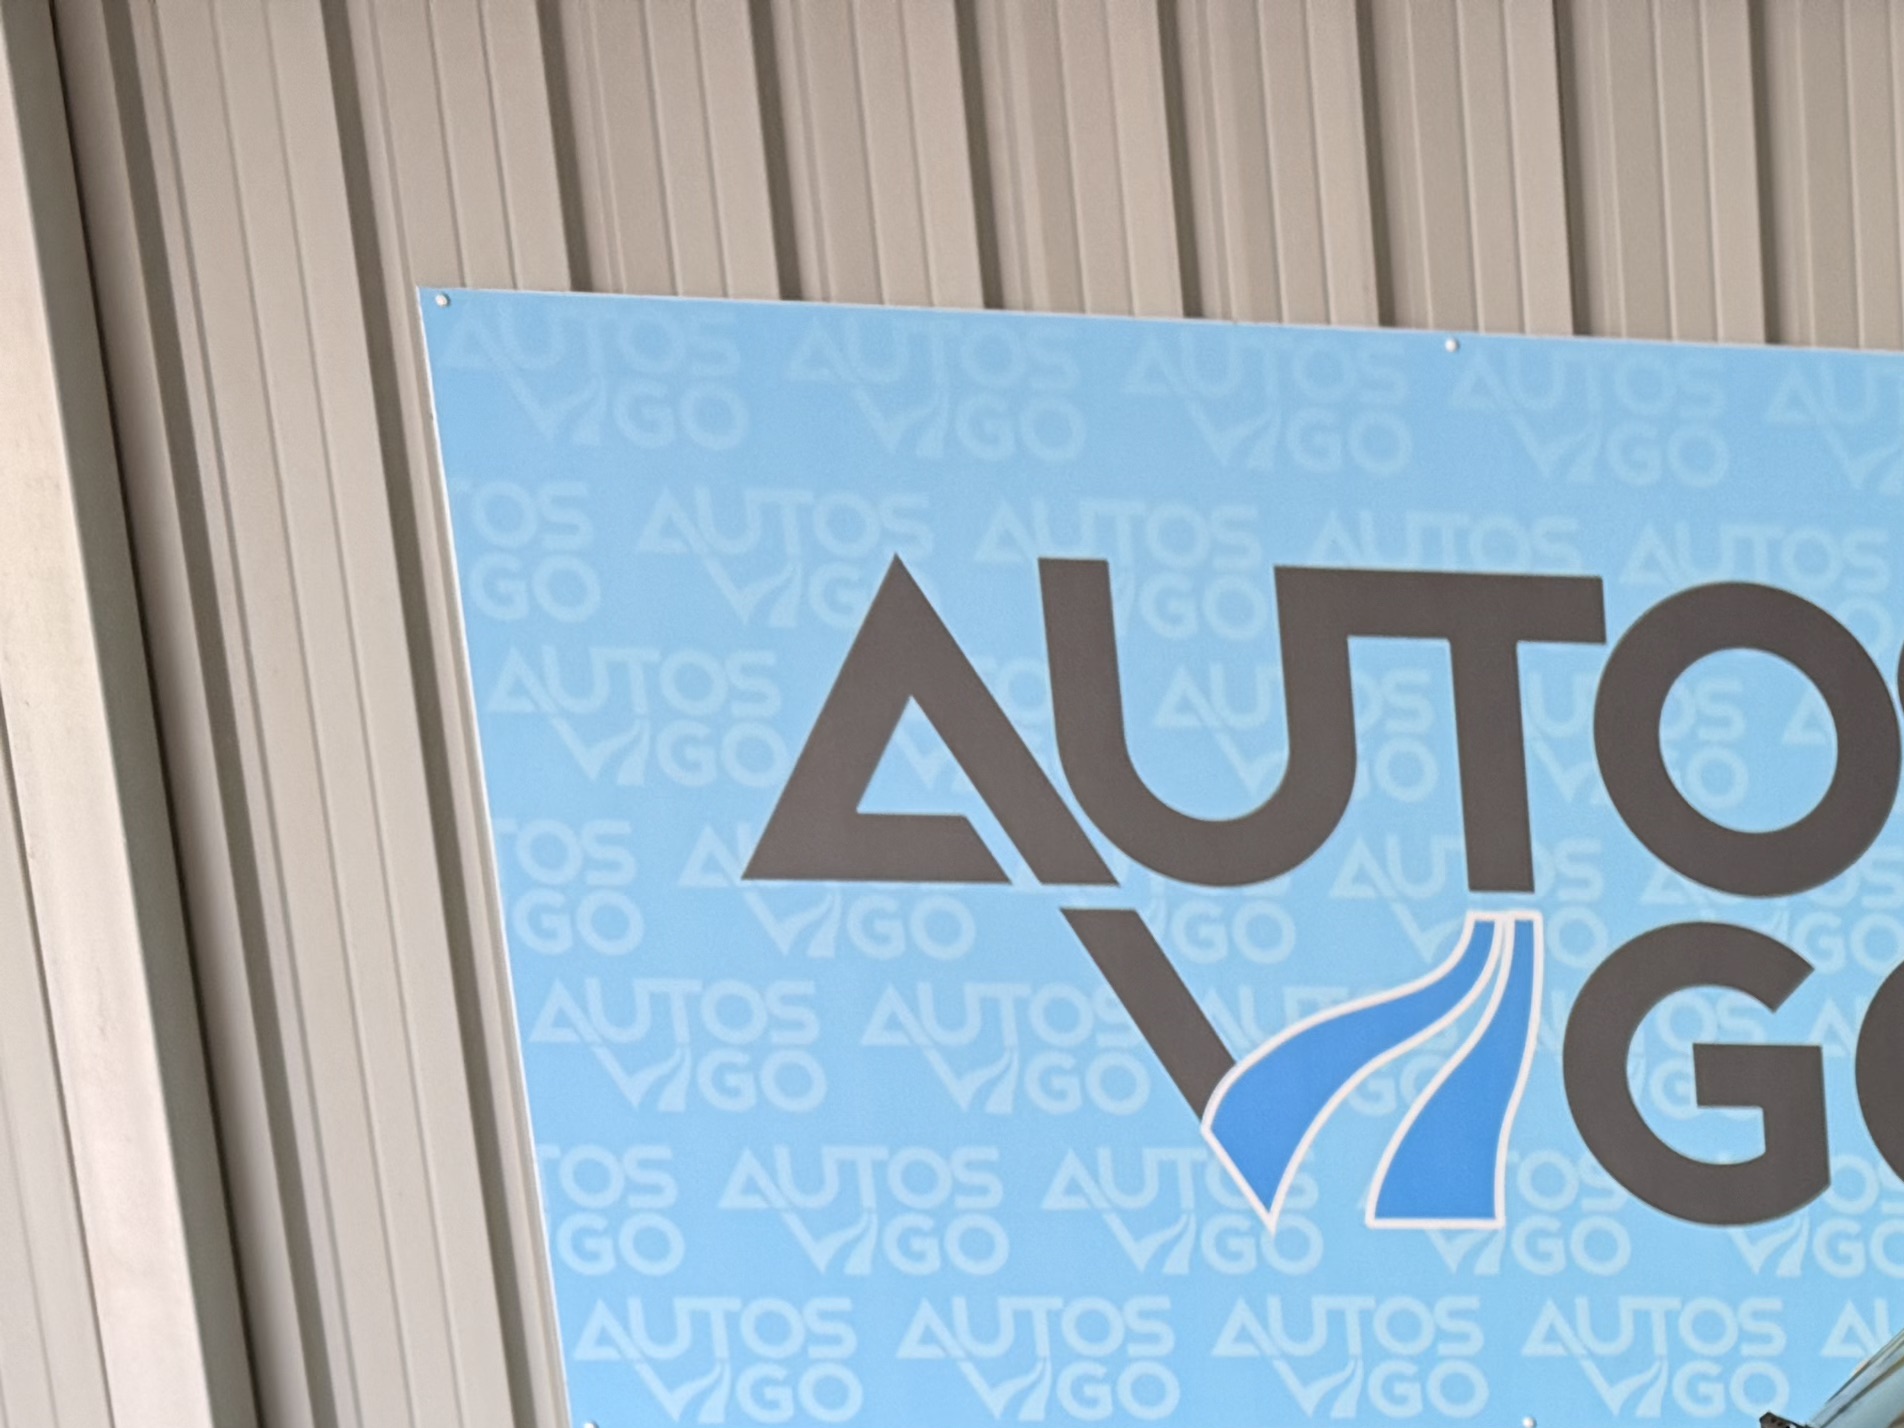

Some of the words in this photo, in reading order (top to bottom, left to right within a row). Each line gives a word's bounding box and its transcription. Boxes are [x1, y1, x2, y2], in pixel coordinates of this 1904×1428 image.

[440, 300, 742, 378] AUTOS
[786, 315, 1079, 392] AUTOS
[1122, 330, 1406, 405] AUTOS
[1447, 344, 1723, 418] AUTOS
[639, 487, 933, 562] AUTOS
[976, 499, 1262, 573] AUTOS
[1303, 511, 1581, 583] AUTOS
[1621, 522, 1891, 593] AUTOS
[486, 644, 782, 717] AUTOS
[551, 716, 789, 786] VIGO
[744, 892, 975, 959] VIGO
[530, 978, 820, 1044] AUTOS
[594, 1046, 827, 1111] VIGO
[925, 1049, 1150, 1114] VIGO
[720, 1145, 1003, 1209] AUTOS
[783, 1211, 1009, 1274] VIGO
[1105, 1212, 1325, 1274] VIGO
[573, 1297, 857, 1359] AUTOS
[899, 1297, 1175, 1358] AUTOS
[1215, 1296, 1484, 1356] AUTOS
[1522, 1296, 1784, 1355] AUTOS
[635, 1362, 864, 1424] VIGO
[960, 1360, 1180, 1422] VIGO
[1274, 1359, 1488, 1420] VIGO
[1580, 1358, 1787, 1418] VIGO
